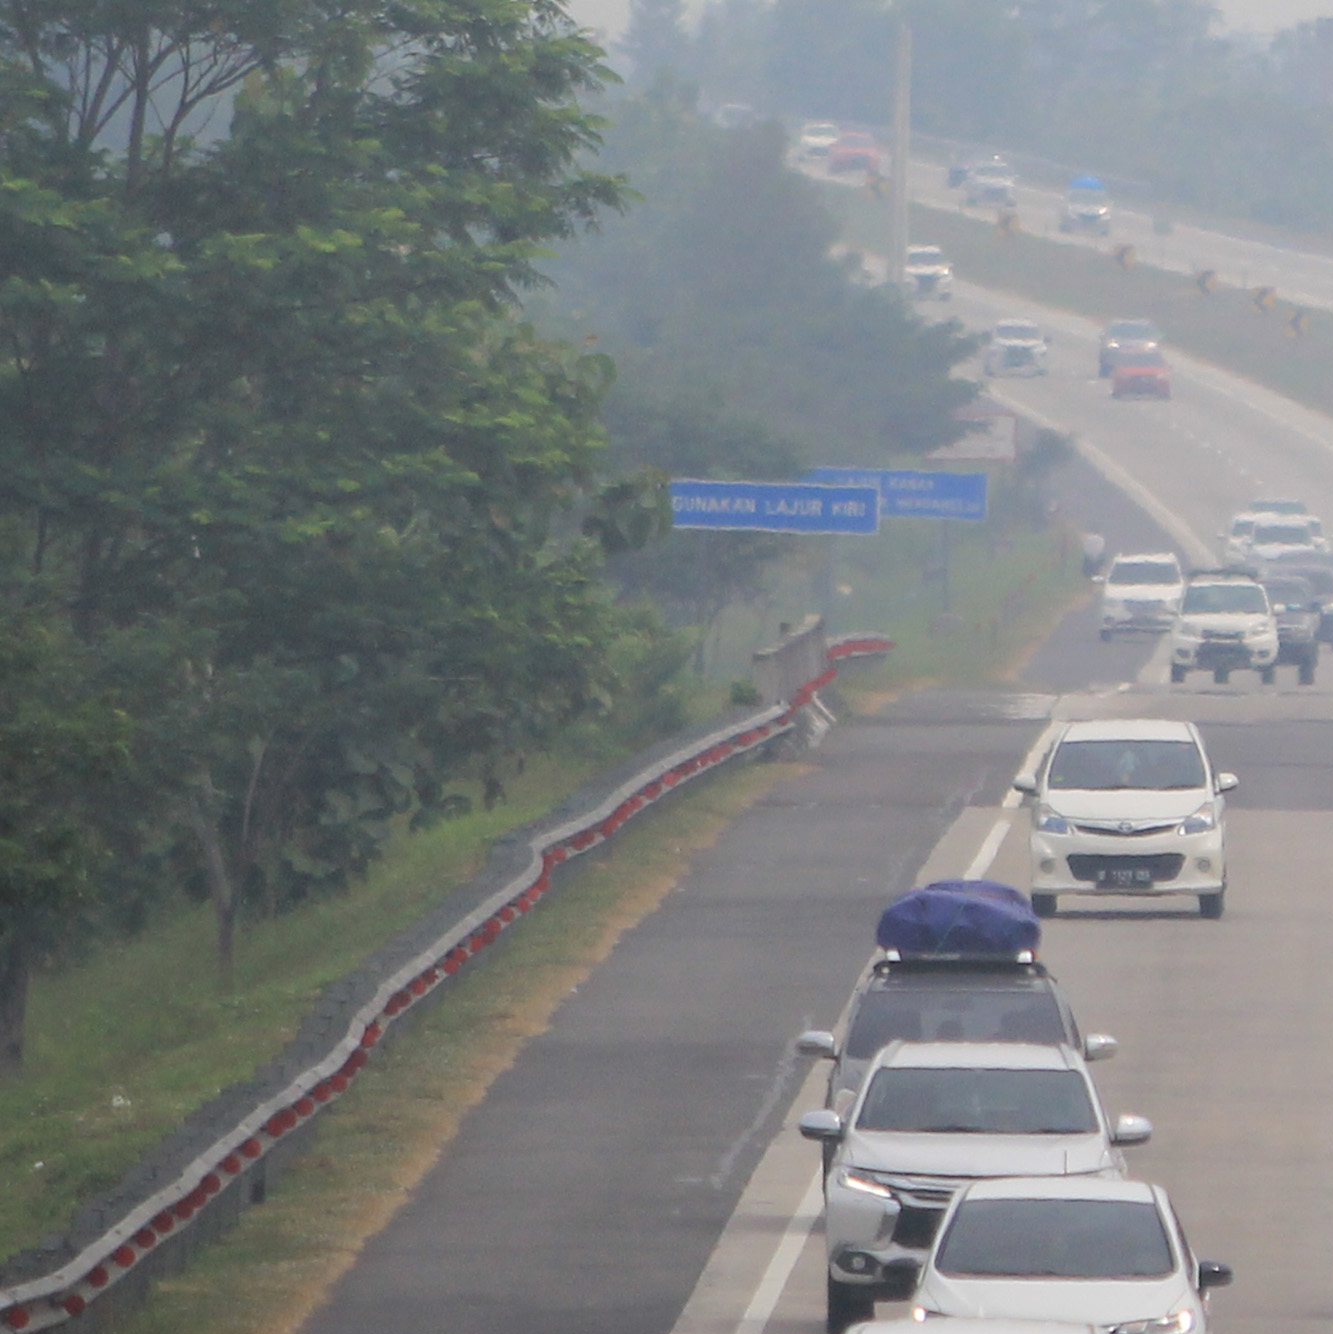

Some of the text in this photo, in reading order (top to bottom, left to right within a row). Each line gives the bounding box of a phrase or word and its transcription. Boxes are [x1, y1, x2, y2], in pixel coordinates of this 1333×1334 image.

[671, 495, 756, 513] GUNAKAN
[764, 498, 822, 516] LAJUR
[831, 501, 866, 518] KIRI
